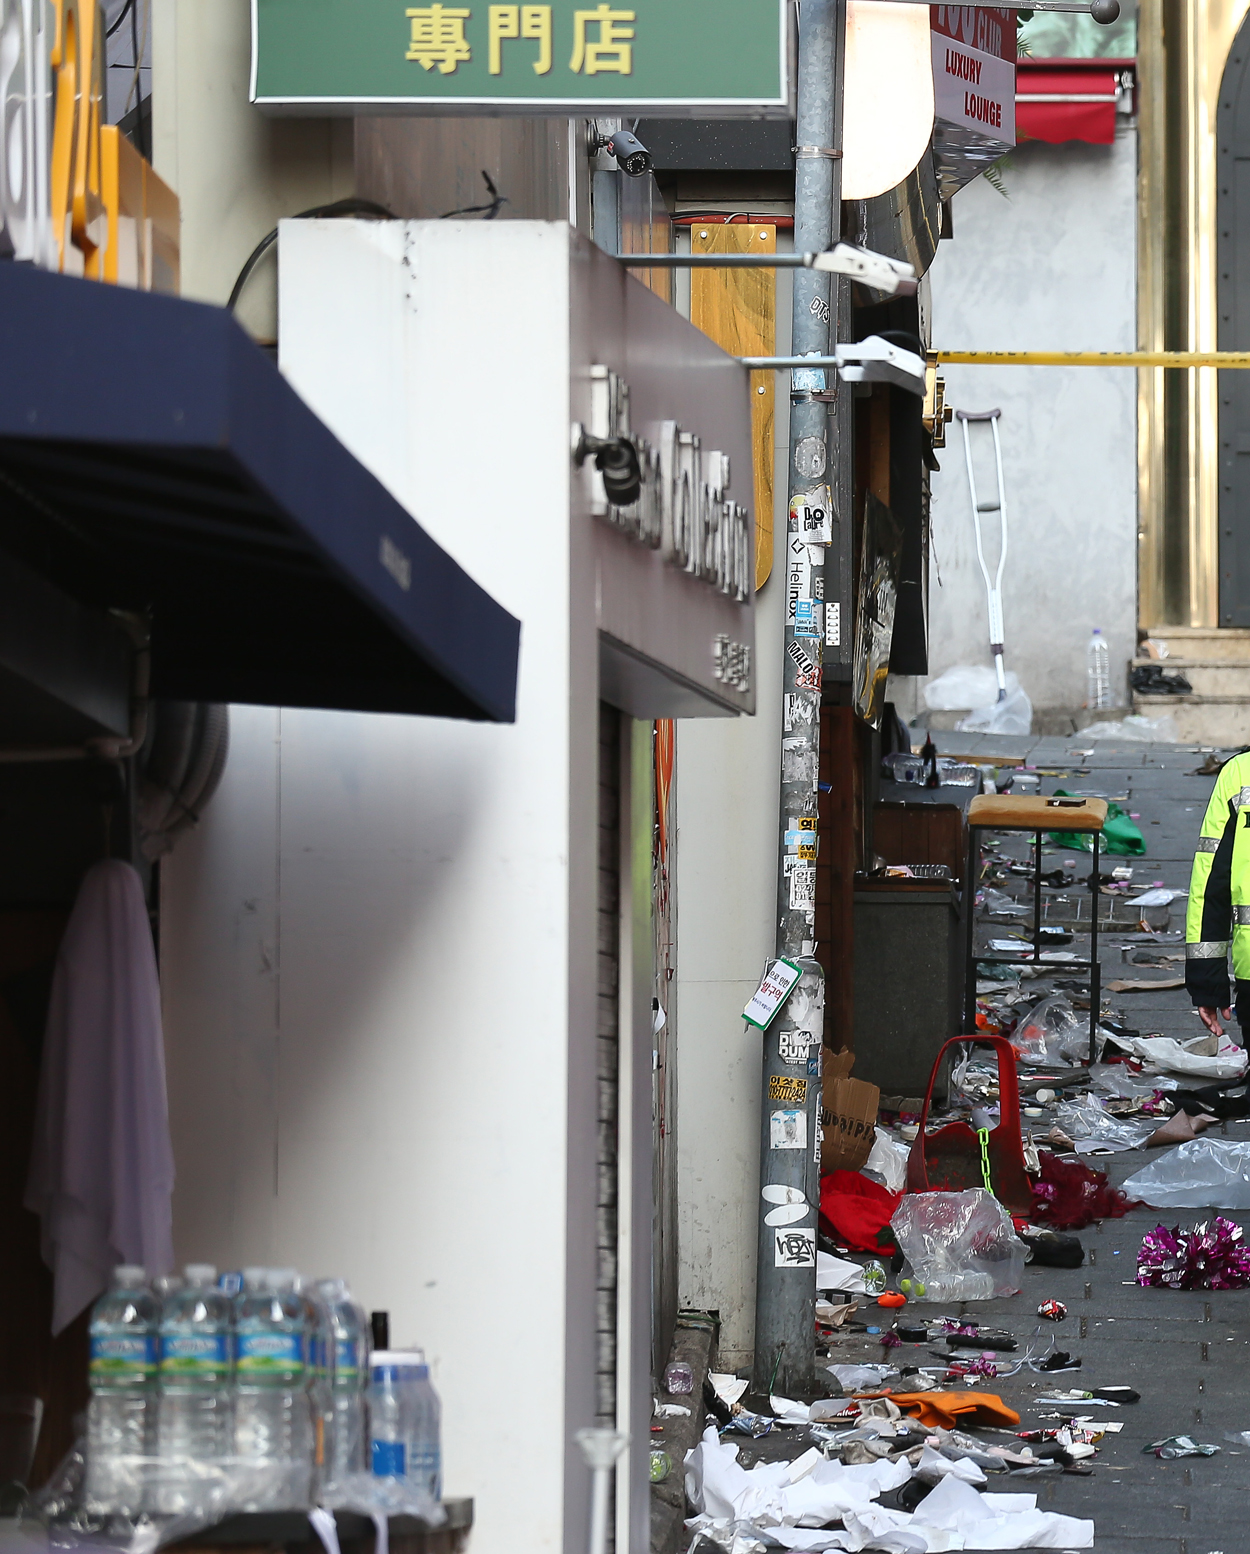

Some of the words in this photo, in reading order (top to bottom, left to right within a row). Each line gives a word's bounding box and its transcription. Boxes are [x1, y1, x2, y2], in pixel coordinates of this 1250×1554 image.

[405, 3, 636, 76] 專門店
[946, 48, 982, 85] LUXURY
[964, 91, 1002, 128] LOUNGE
[789, 562, 804, 619] Helinox
